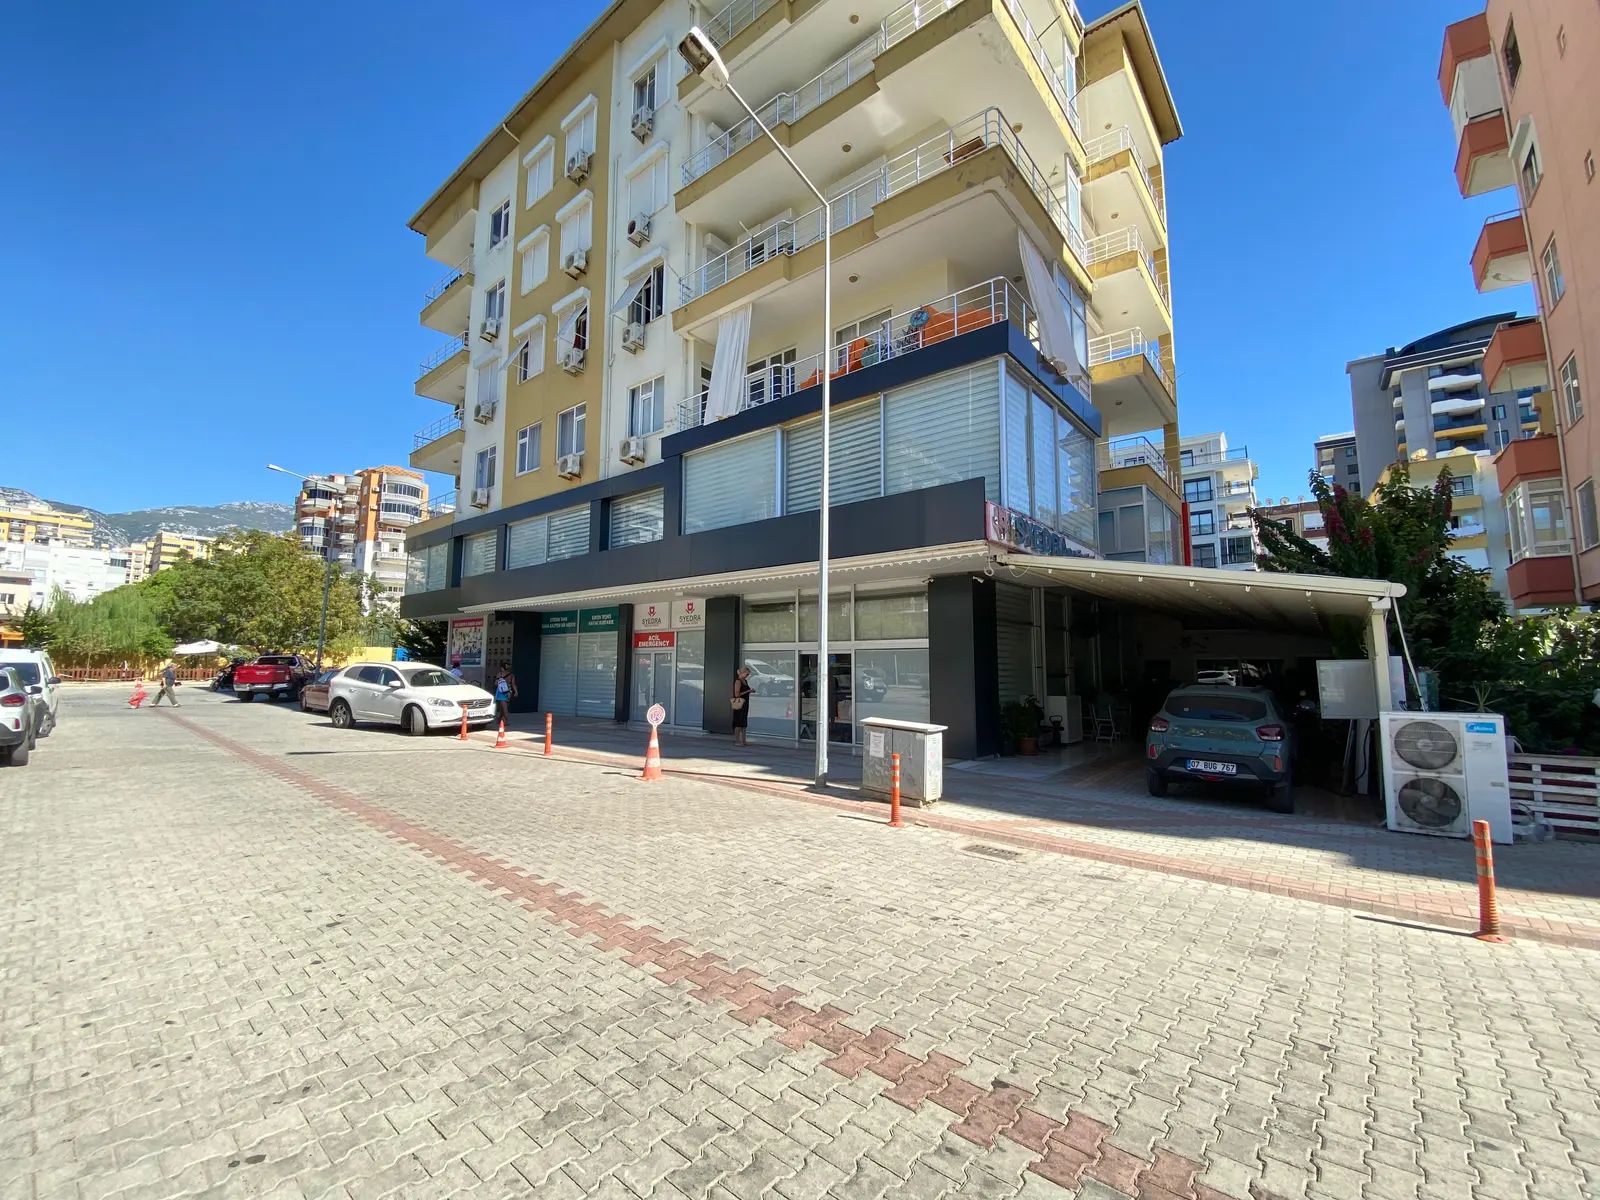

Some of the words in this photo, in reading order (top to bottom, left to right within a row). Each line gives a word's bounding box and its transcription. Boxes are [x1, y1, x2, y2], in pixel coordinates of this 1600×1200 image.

[641, 617, 662, 625] SYEDRA
[678, 614, 702, 623] SYEDRA
[1190, 760, 1200, 768] 07
[1203, 761, 1218, 770] BUG
[1221, 763, 1236, 772] 767
